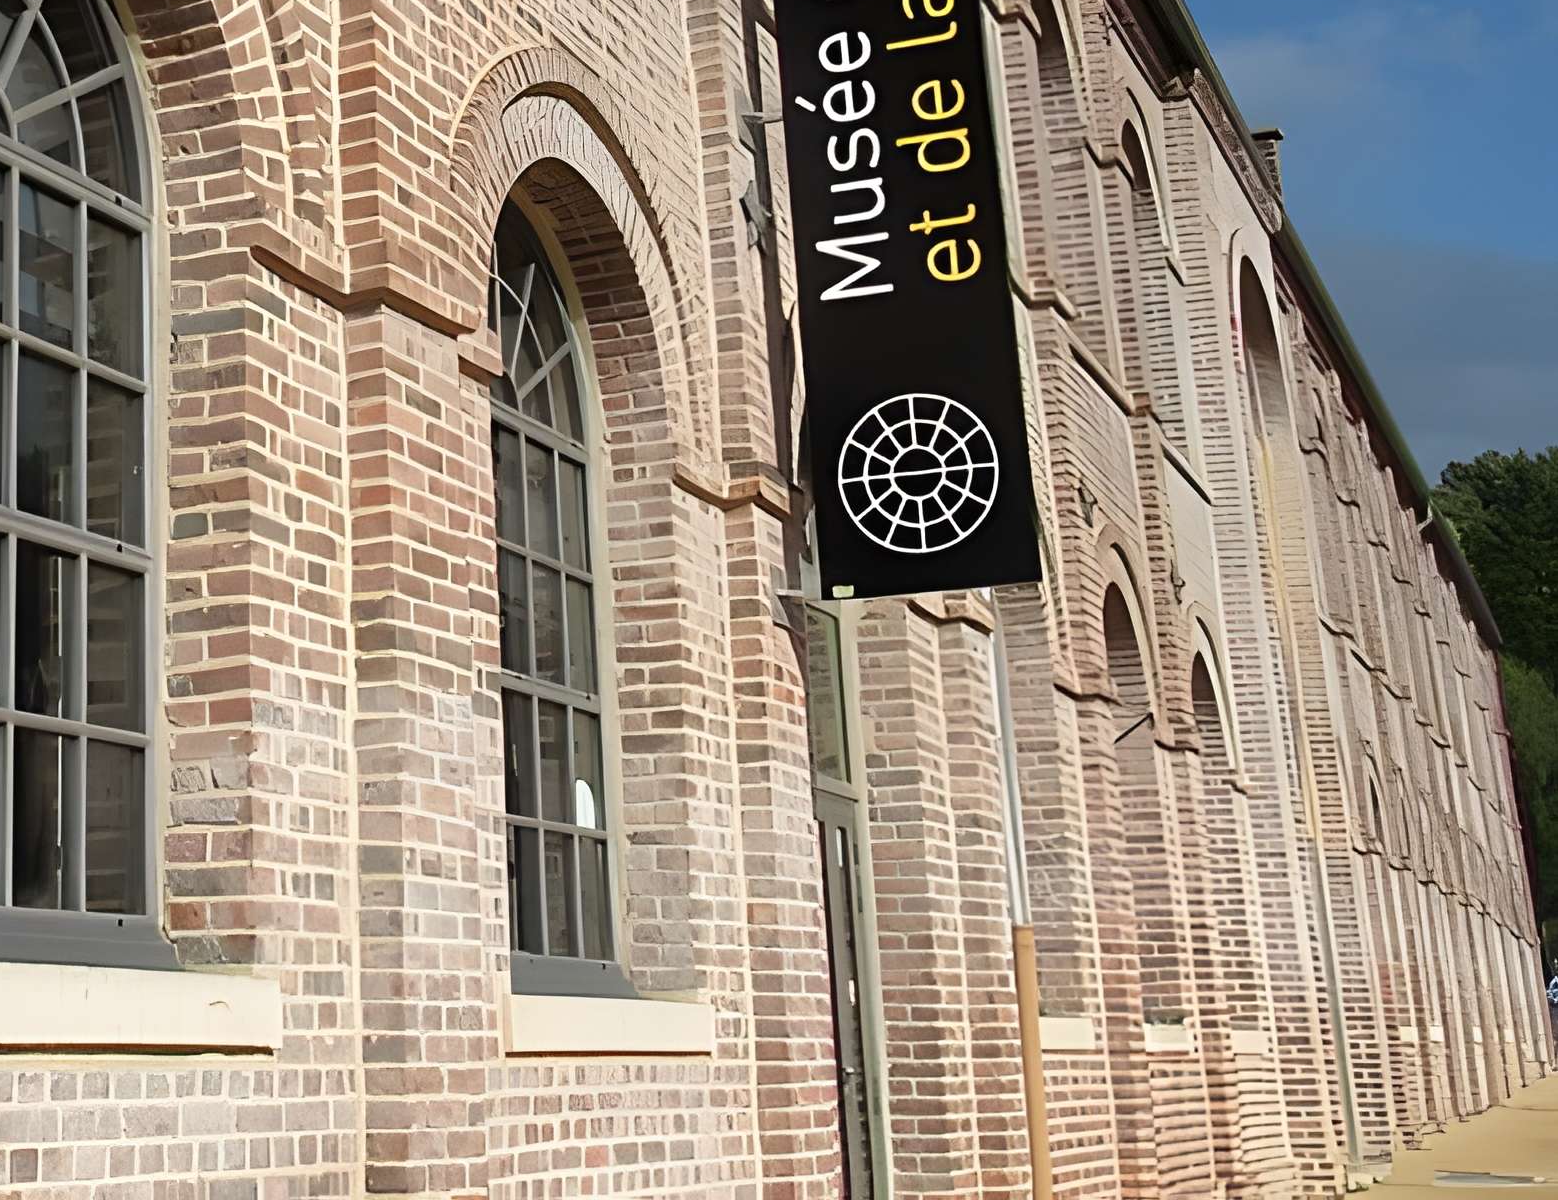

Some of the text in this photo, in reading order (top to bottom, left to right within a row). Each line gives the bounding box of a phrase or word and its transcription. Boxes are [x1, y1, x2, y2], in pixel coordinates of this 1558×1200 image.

[794, 31, 894, 301] Musée
[895, 79, 971, 173] de
[909, 203, 982, 282] et
